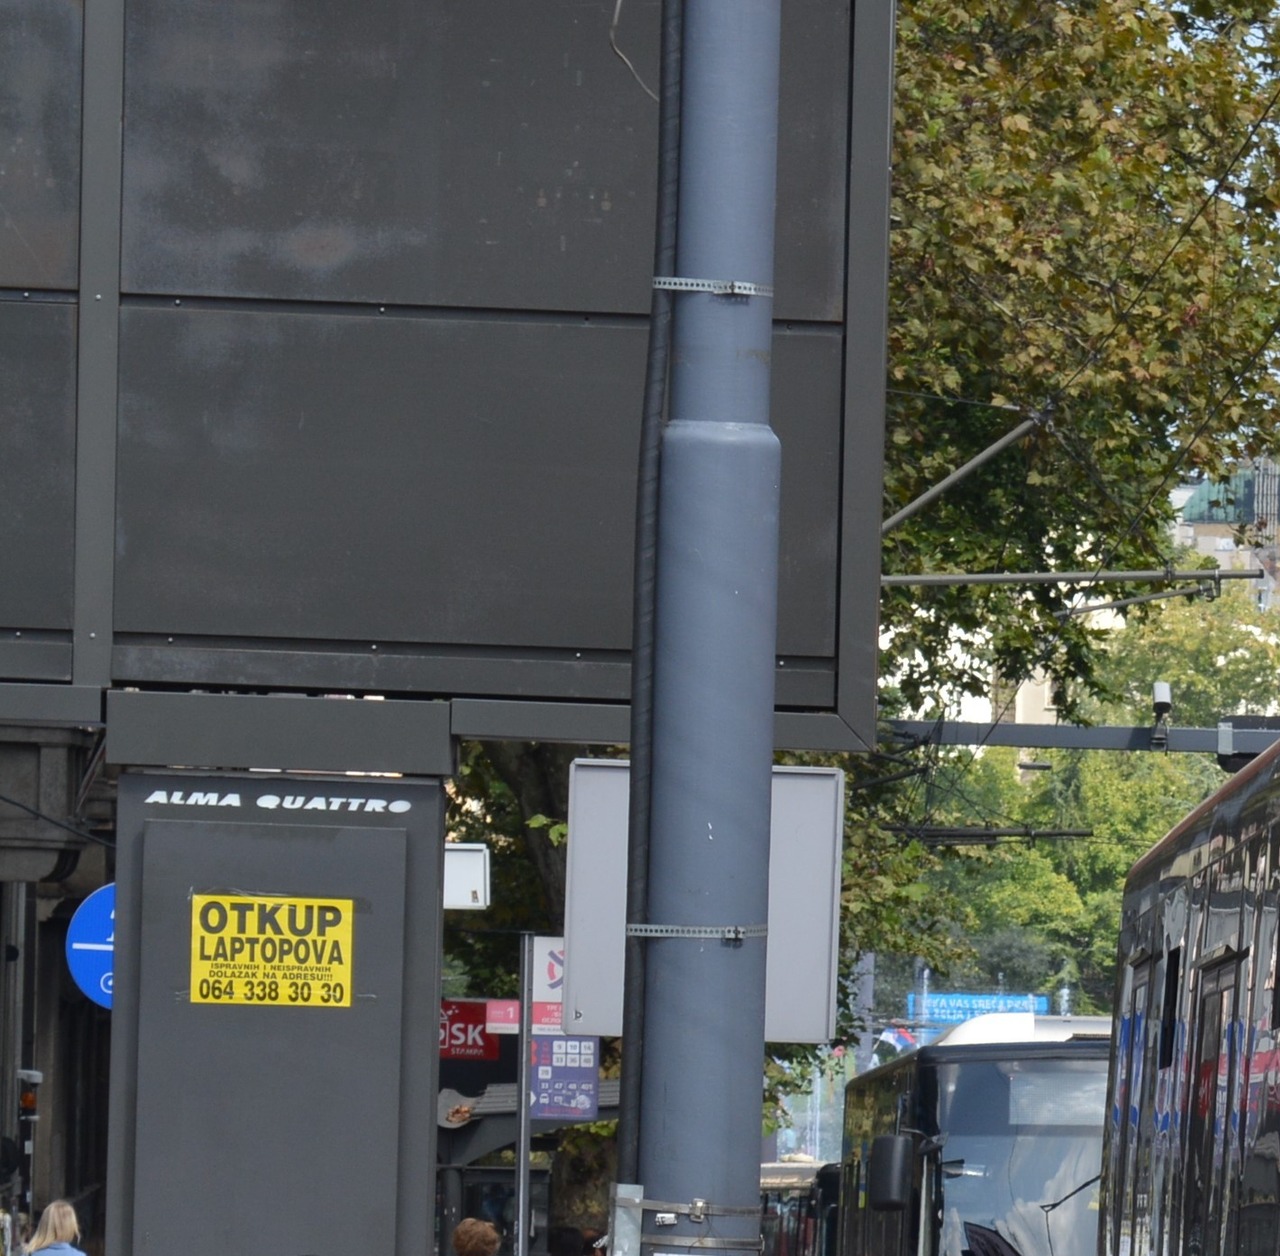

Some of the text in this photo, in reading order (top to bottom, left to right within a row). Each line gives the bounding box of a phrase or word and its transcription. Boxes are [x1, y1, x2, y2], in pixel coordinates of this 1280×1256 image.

[144, 790, 411, 813] ALMA QUATTRO
[199, 900, 342, 937] OTKUP
[199, 936, 344, 965] LAPTOPOVA
[208, 970, 333, 982] DOLAZAK NA ADRESU!!!
[210, 962, 260, 971] ISPRAVNIH
[269, 964, 332, 973] NEISPRAVNIH
[199, 979, 344, 1004] 064 338 30 30
